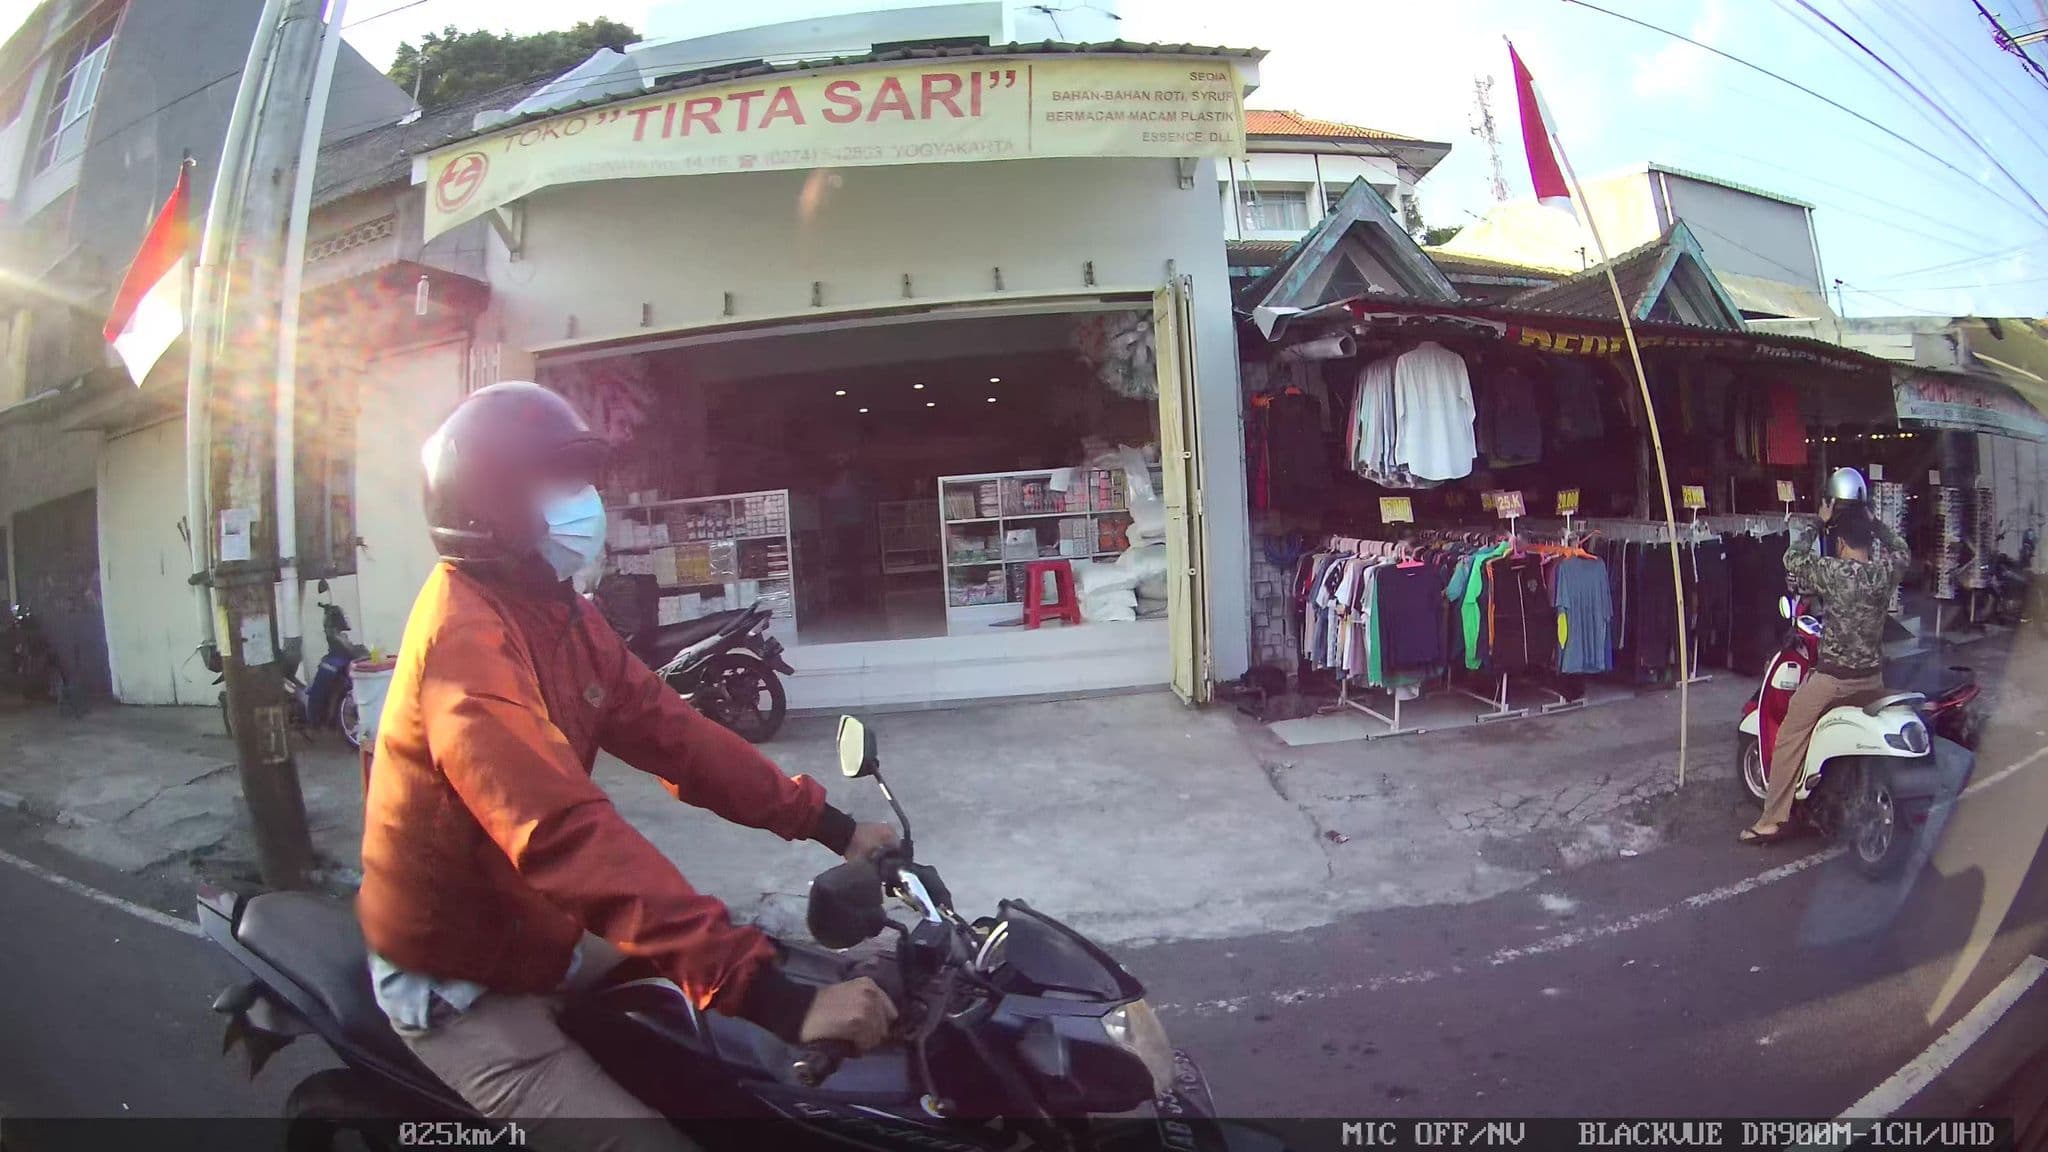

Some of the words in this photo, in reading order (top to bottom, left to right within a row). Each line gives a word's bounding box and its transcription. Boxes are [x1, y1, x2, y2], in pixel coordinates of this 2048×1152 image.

[1052, 90, 1151, 101] BAHAN-BAHAN
[1181, 111, 1234, 122] PLASTIK
[503, 116, 587, 153] TOKO
